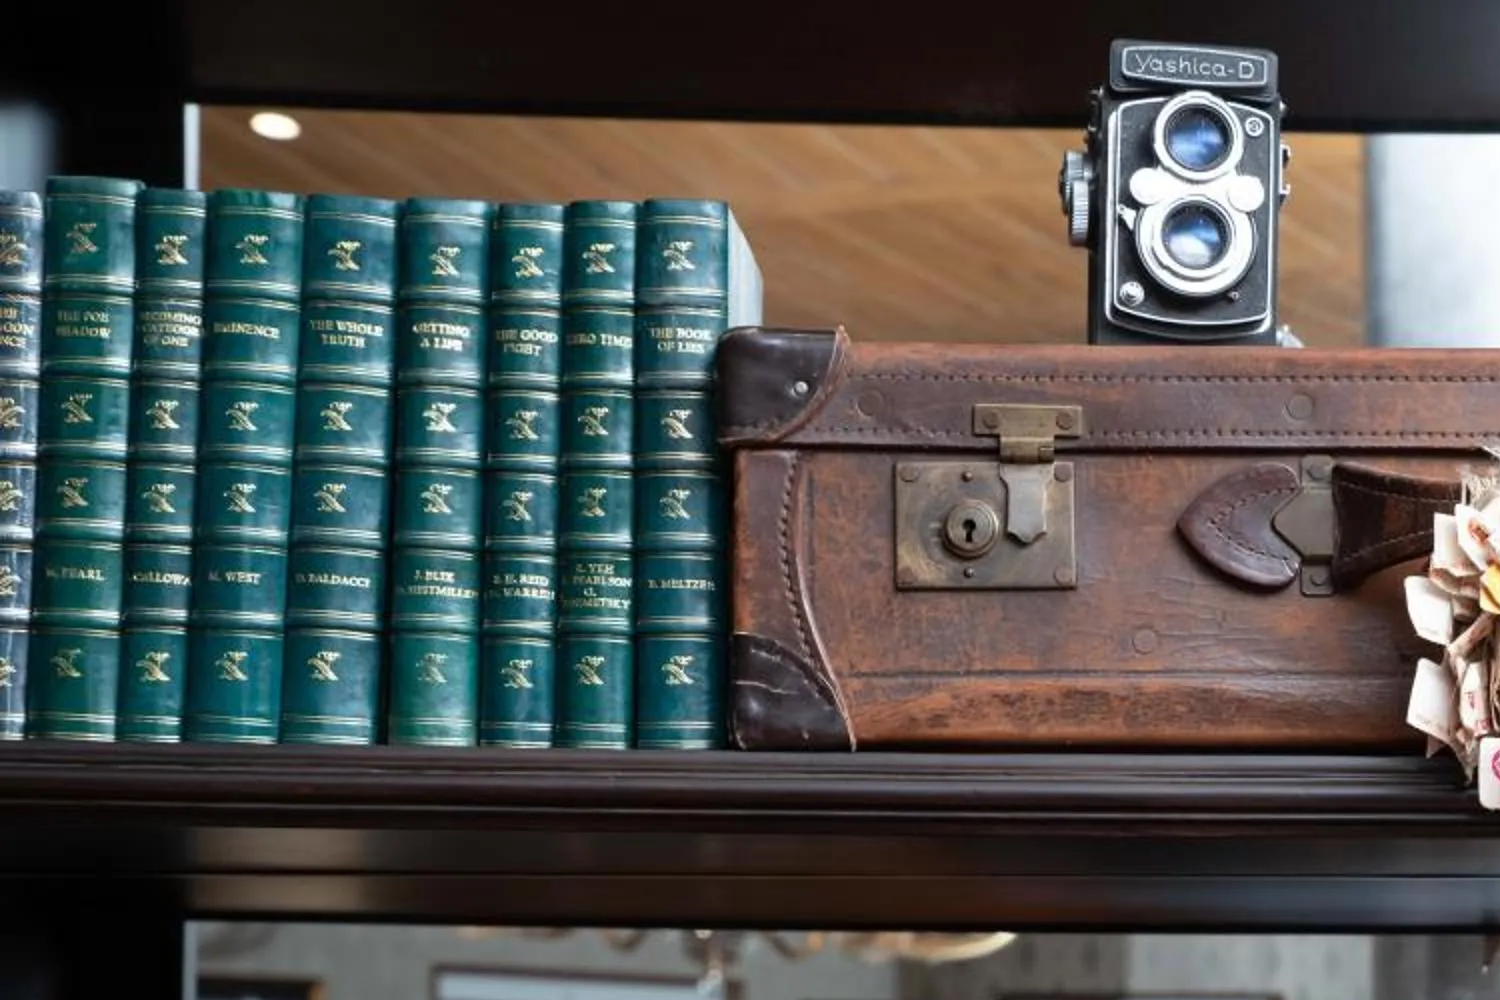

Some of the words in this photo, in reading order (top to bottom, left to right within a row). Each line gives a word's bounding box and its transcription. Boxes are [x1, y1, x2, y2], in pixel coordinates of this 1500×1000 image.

[1135, 54, 1256, 79] Yashica-D
[336, 320, 383, 336] WHOLE
[412, 322, 470, 337] GETTING
[676, 328, 712, 341] BOOK
[321, 334, 365, 348] TRUTH
[420, 338, 429, 347] A
[520, 330, 558, 343] GOOD
[657, 341, 674, 352] OF
[225, 570, 261, 584] WEST
[309, 574, 370, 587] BALDACCI
